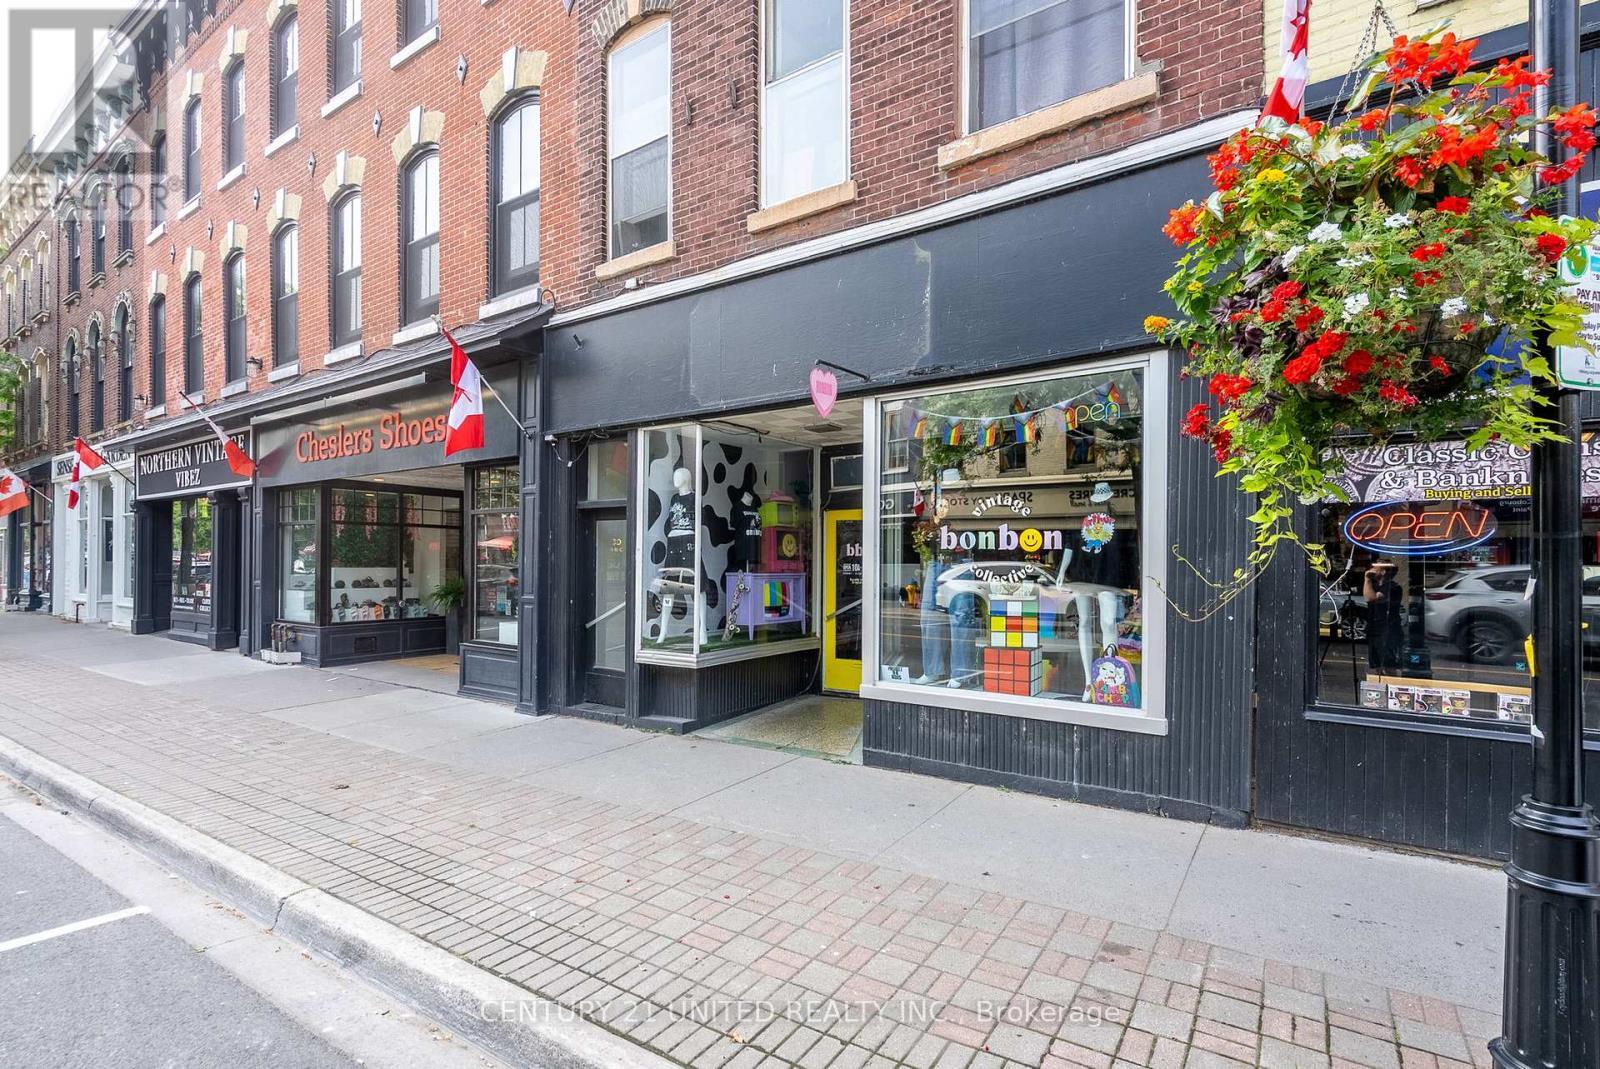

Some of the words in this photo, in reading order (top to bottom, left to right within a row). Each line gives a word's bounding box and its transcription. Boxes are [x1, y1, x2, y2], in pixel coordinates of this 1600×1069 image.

[1577, 287, 1591, 300] PAY
[296, 424, 373, 463] Cheslers
[379, 411, 449, 450] Shoes
[140, 444, 192, 475] NORTHERN
[194, 434, 245, 465] VINTAE
[1383, 445, 1497, 466] Classic
[175, 454, 201, 488] VIBEZ
[1380, 470, 1404, 489] &
[1425, 489, 1472, 500] Buying
[1475, 487, 1501, 497] and
[972, 494, 1032, 517] vintage
[1350, 511, 1489, 540] OPEN
[970, 564, 1034, 585] collective
